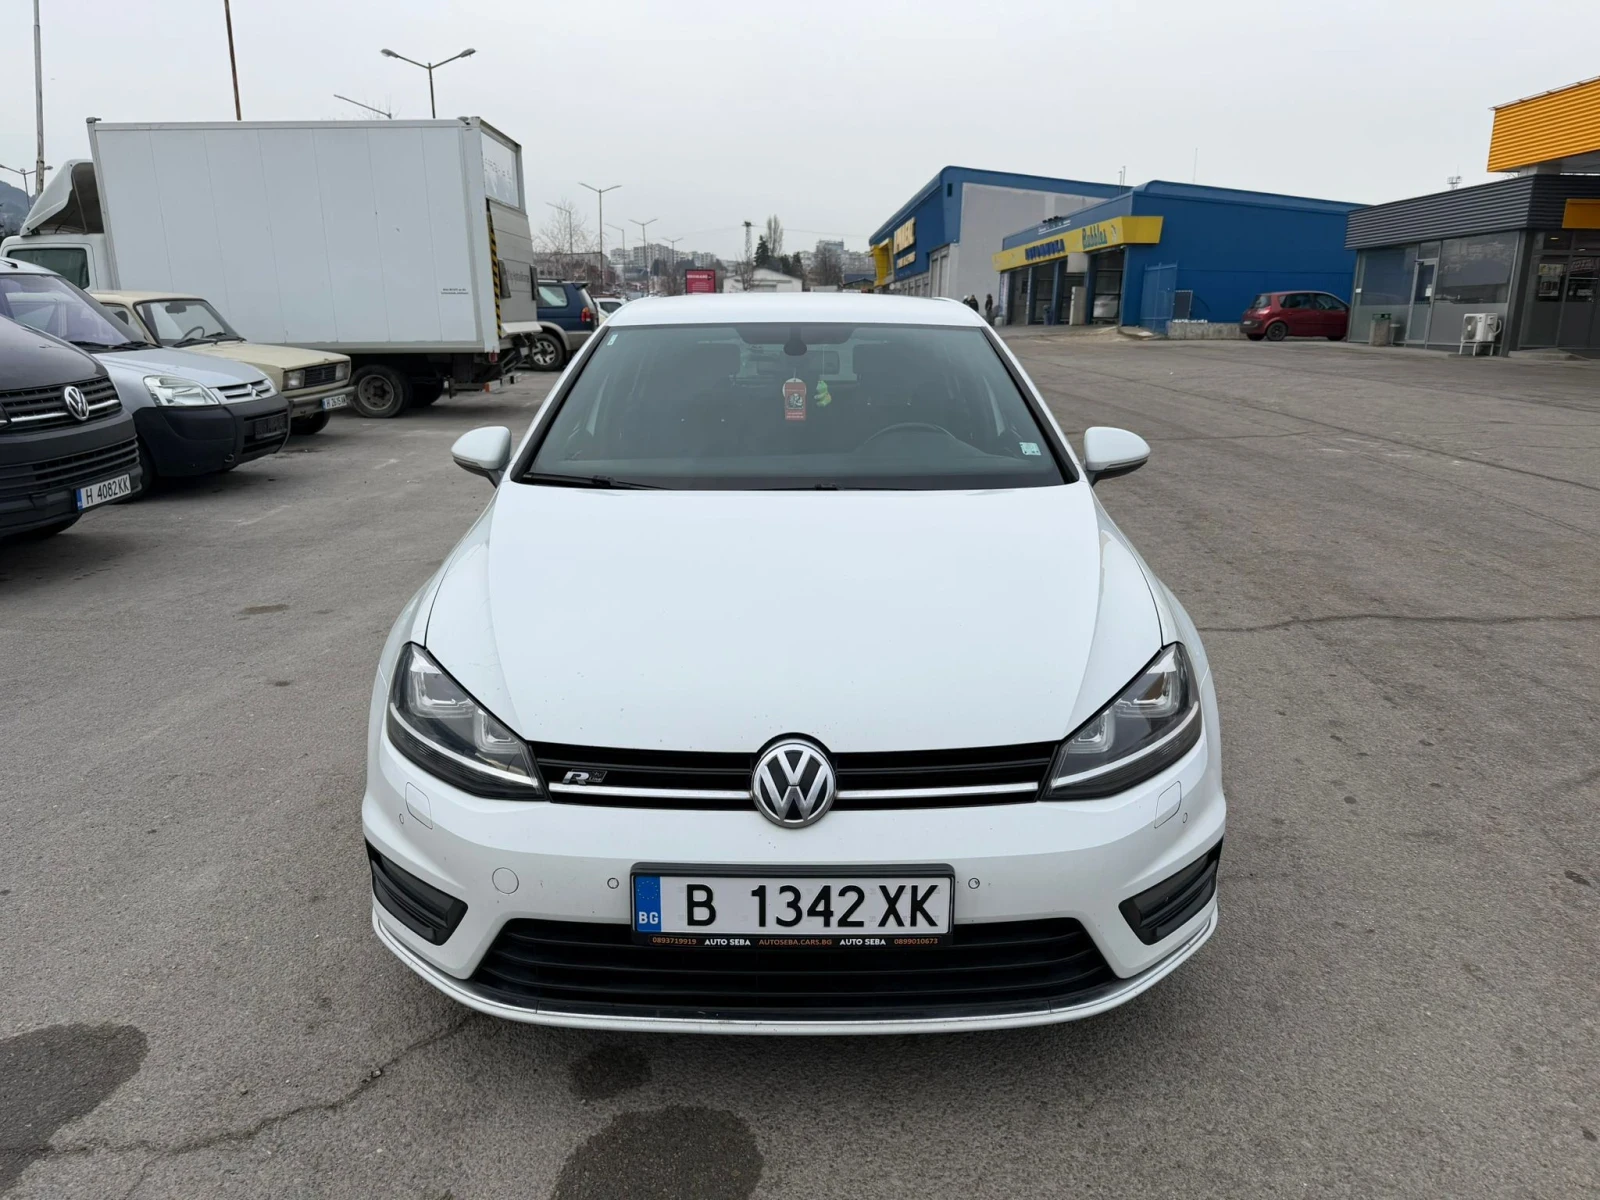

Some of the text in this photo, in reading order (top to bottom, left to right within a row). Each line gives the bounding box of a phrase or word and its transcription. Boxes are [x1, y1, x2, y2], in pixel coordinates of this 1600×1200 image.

[686, 884, 717, 926] B
[751, 885, 866, 928] 1342
[638, 911, 659, 925] BG
[704, 938, 728, 946] AUTO
[729, 938, 751, 946] SEBA
[758, 938, 833, 946] AUTOSEBA.CARS.BG
[839, 938, 863, 946] AUTO
[864, 938, 887, 946] SEBA
